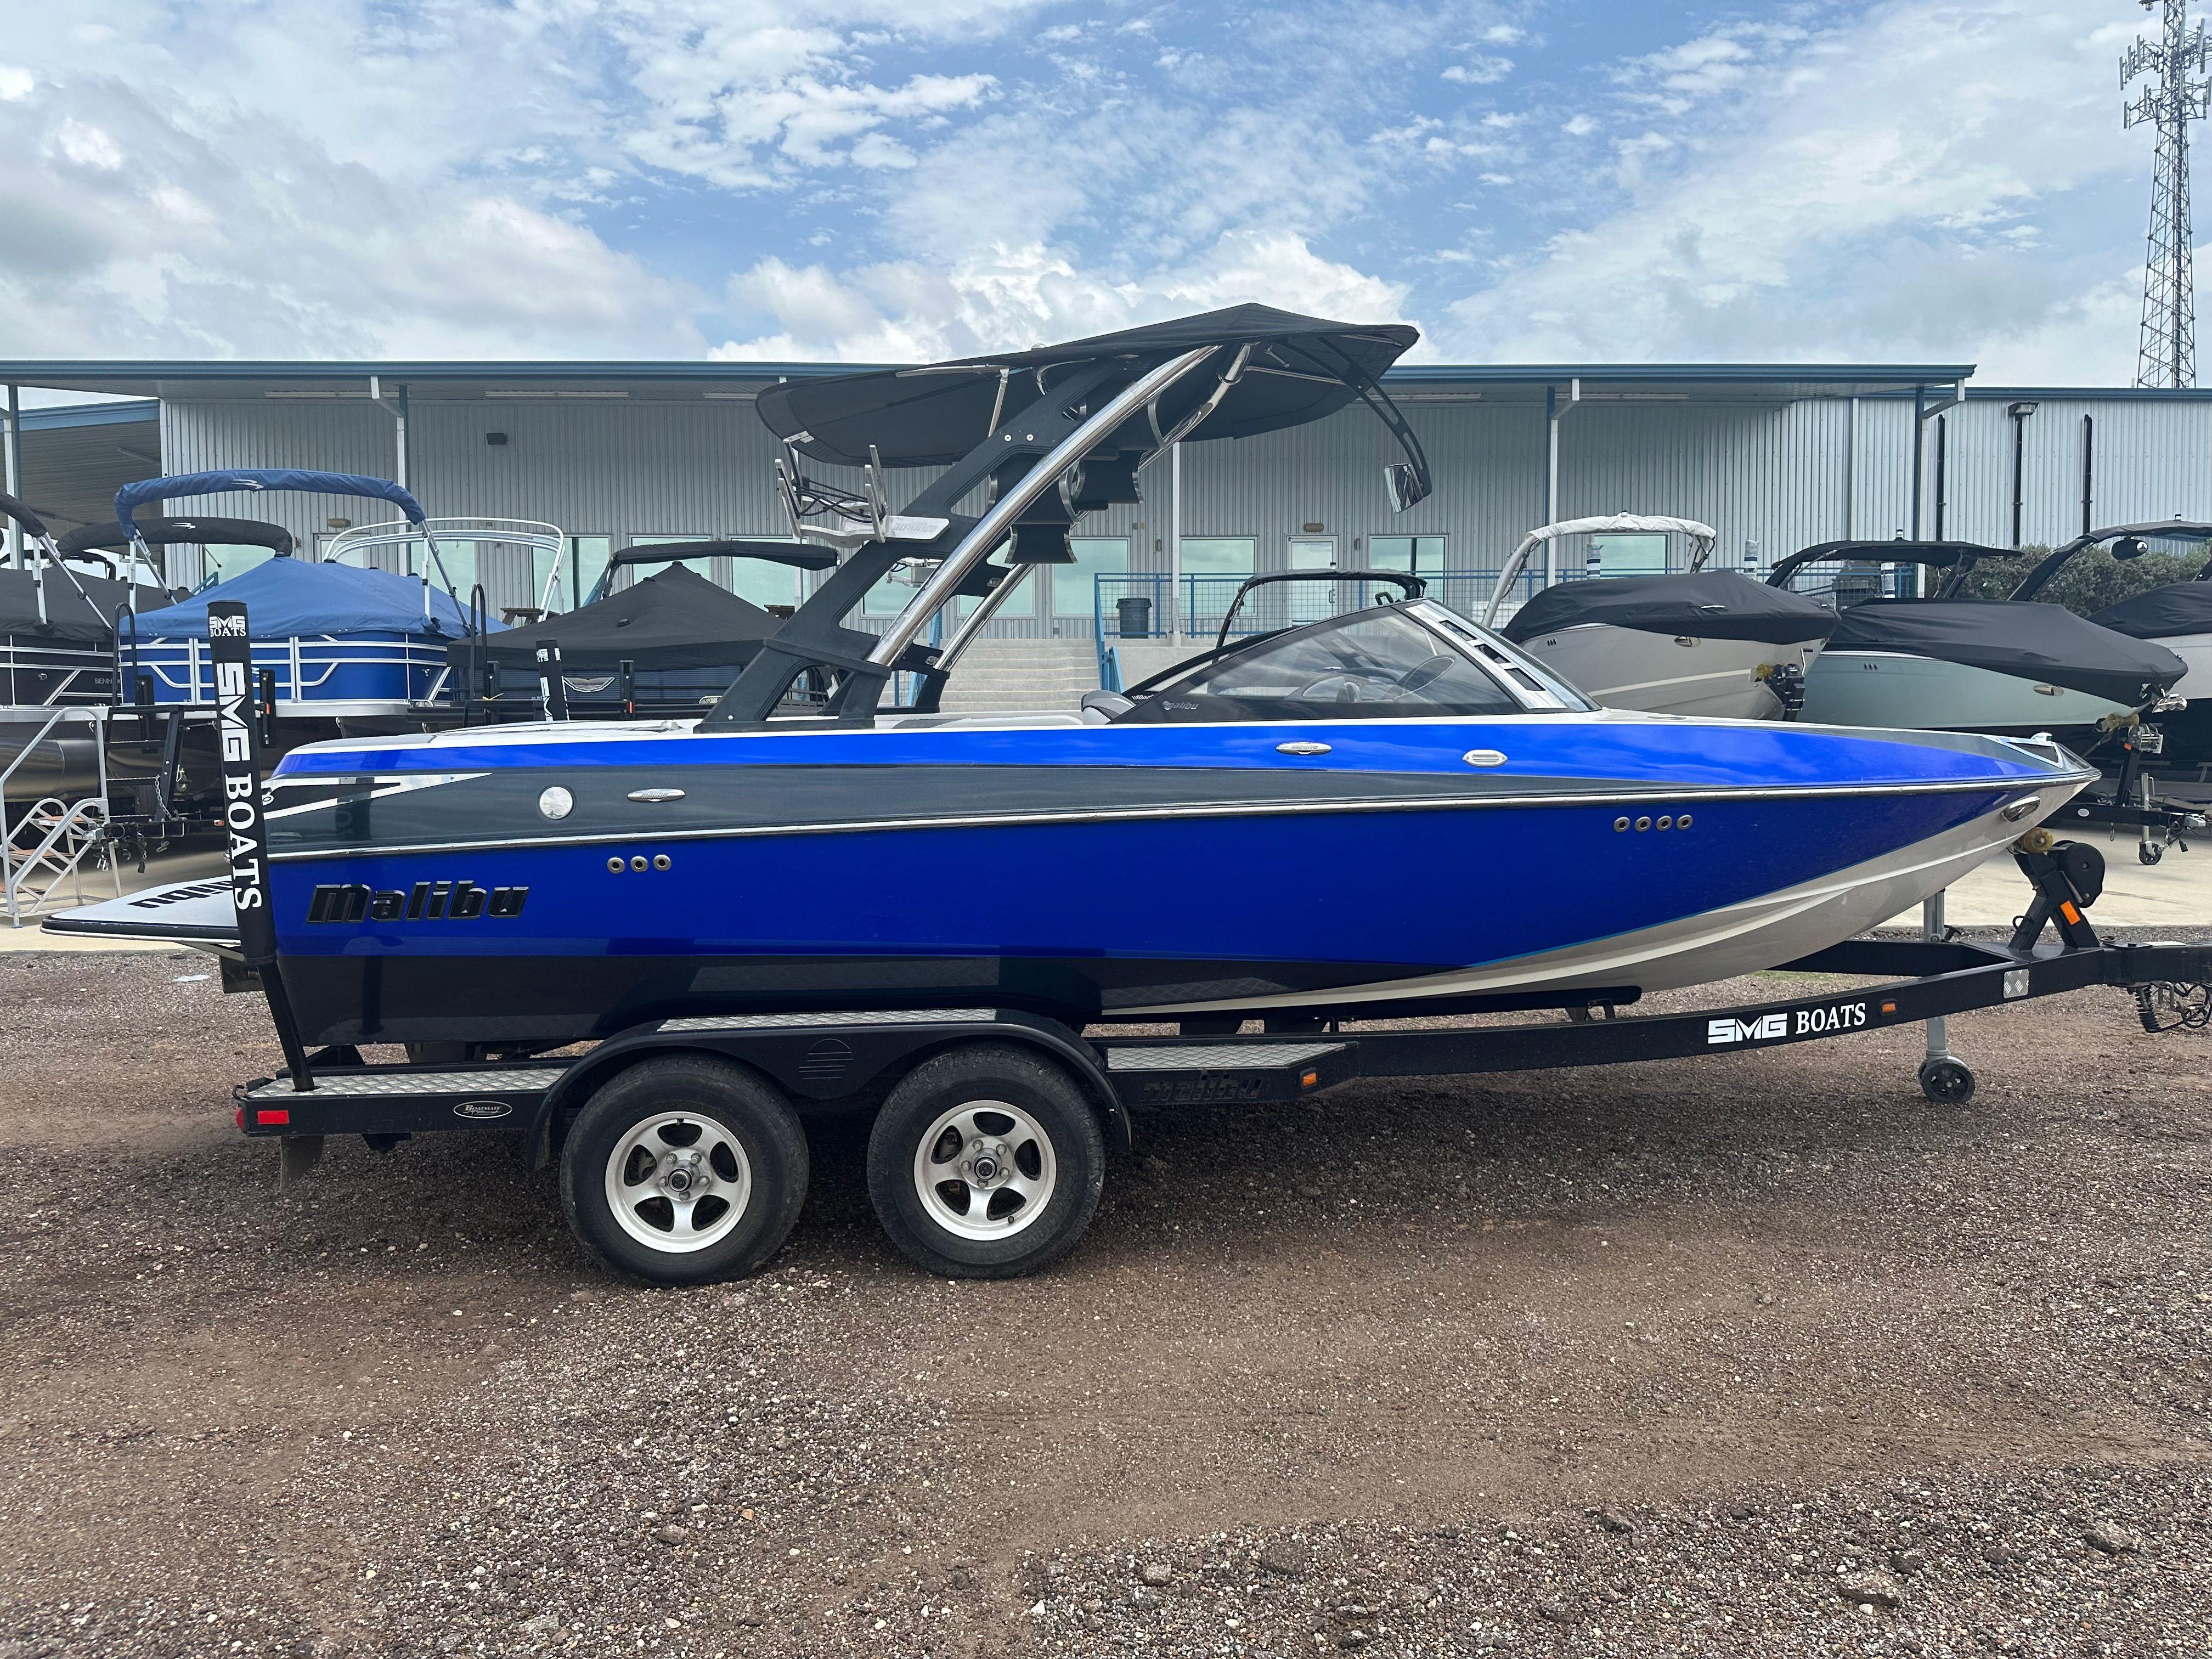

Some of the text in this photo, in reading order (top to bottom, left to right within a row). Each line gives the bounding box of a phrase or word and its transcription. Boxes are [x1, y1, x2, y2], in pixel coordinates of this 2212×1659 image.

[209, 615, 245, 628] SMG
[210, 627, 246, 637] BOATS
[216, 662, 262, 910] SMG BOATS
[1708, 1002, 1866, 1045] SMG BOATS
